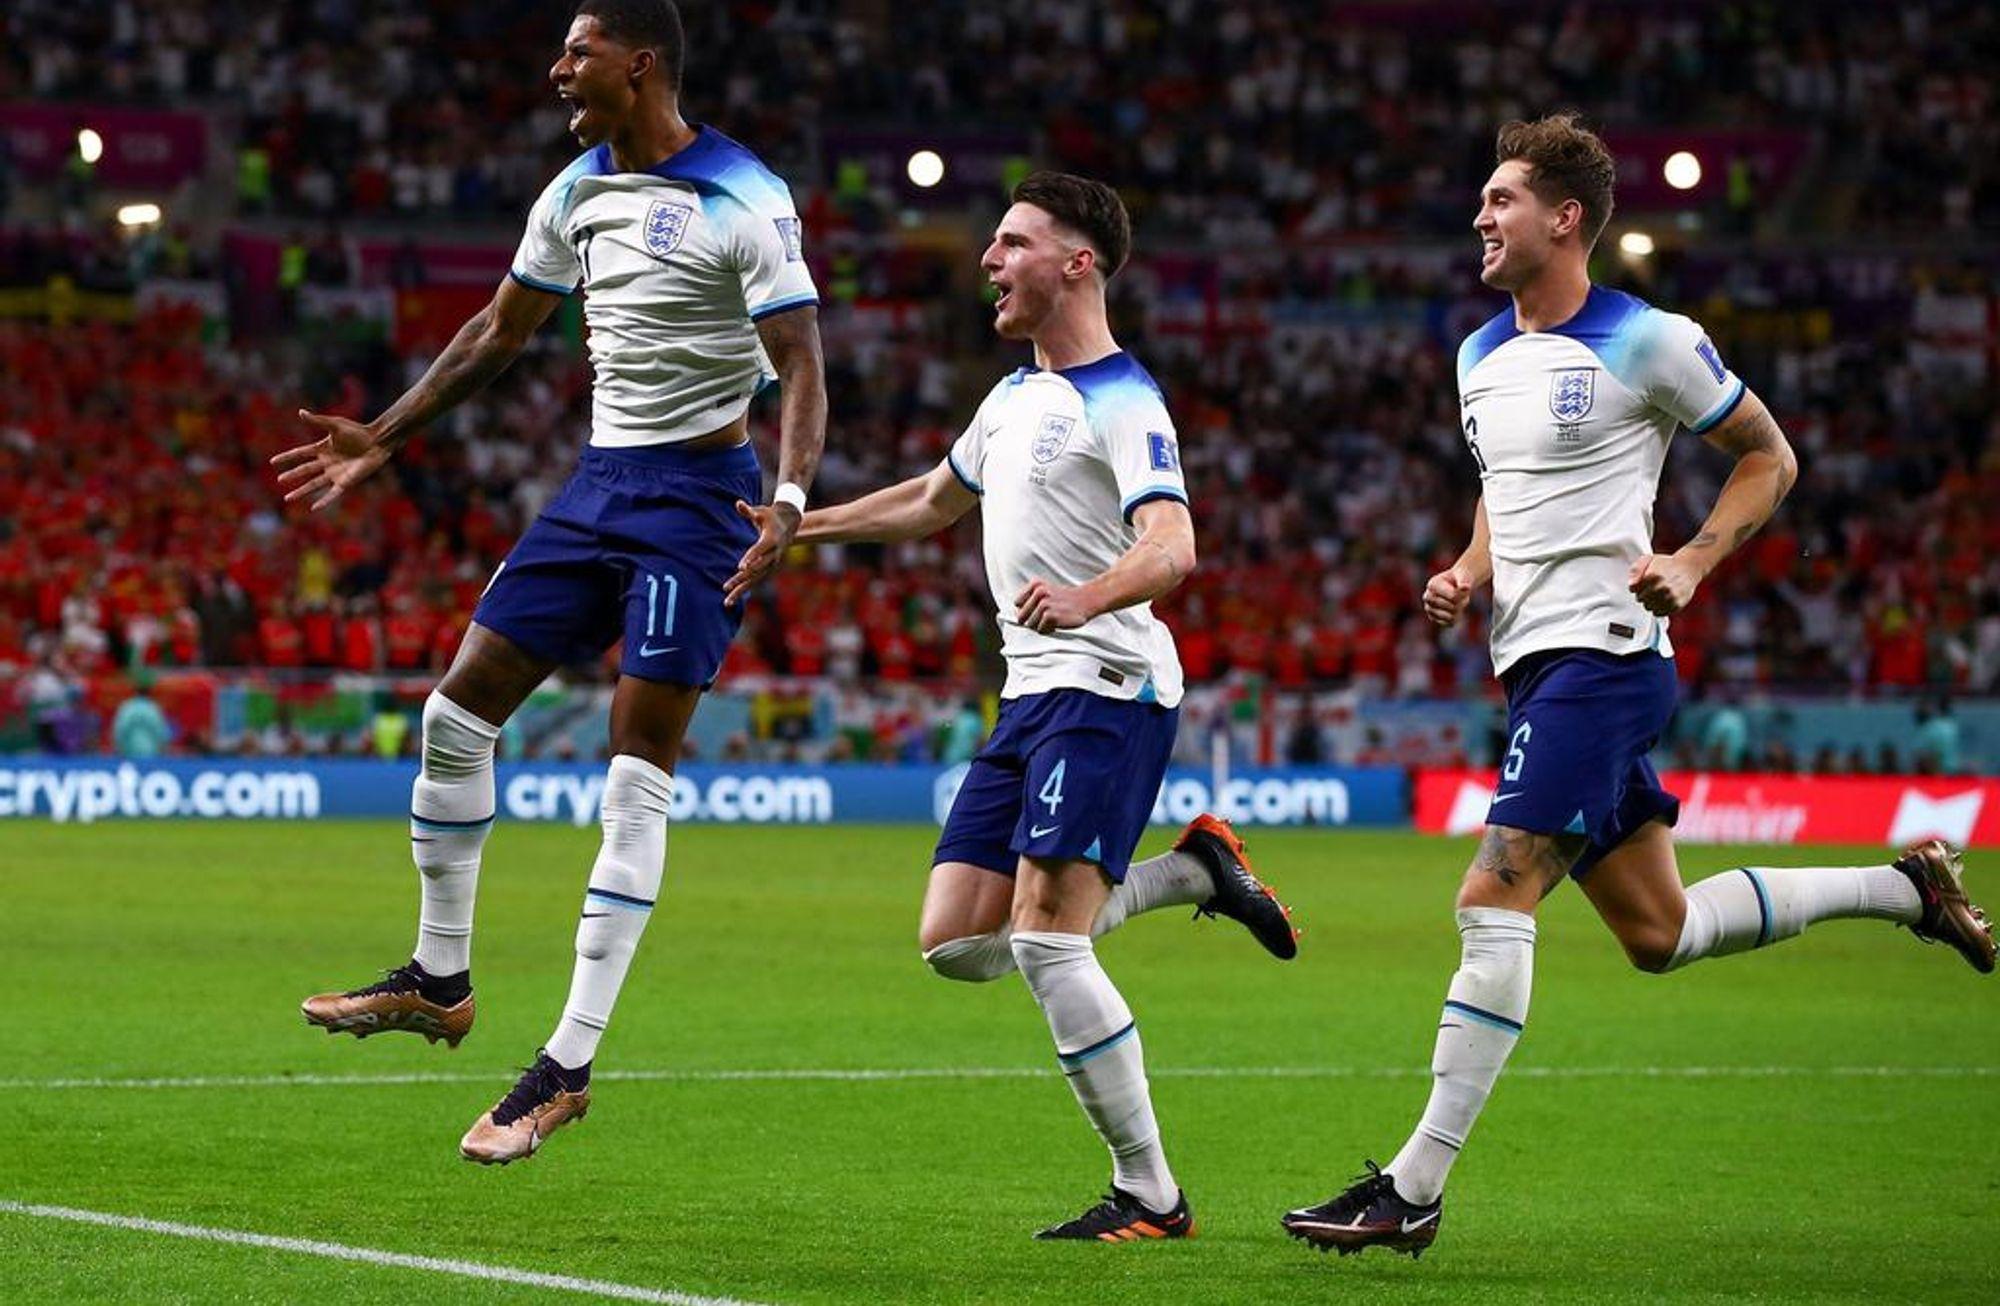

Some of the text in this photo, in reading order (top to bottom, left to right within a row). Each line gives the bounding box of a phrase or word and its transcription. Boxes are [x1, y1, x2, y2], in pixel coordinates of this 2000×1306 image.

[646, 574, 678, 637] 11
[506, 774, 833, 826] cryo.com
[1038, 758, 1067, 816] 4
